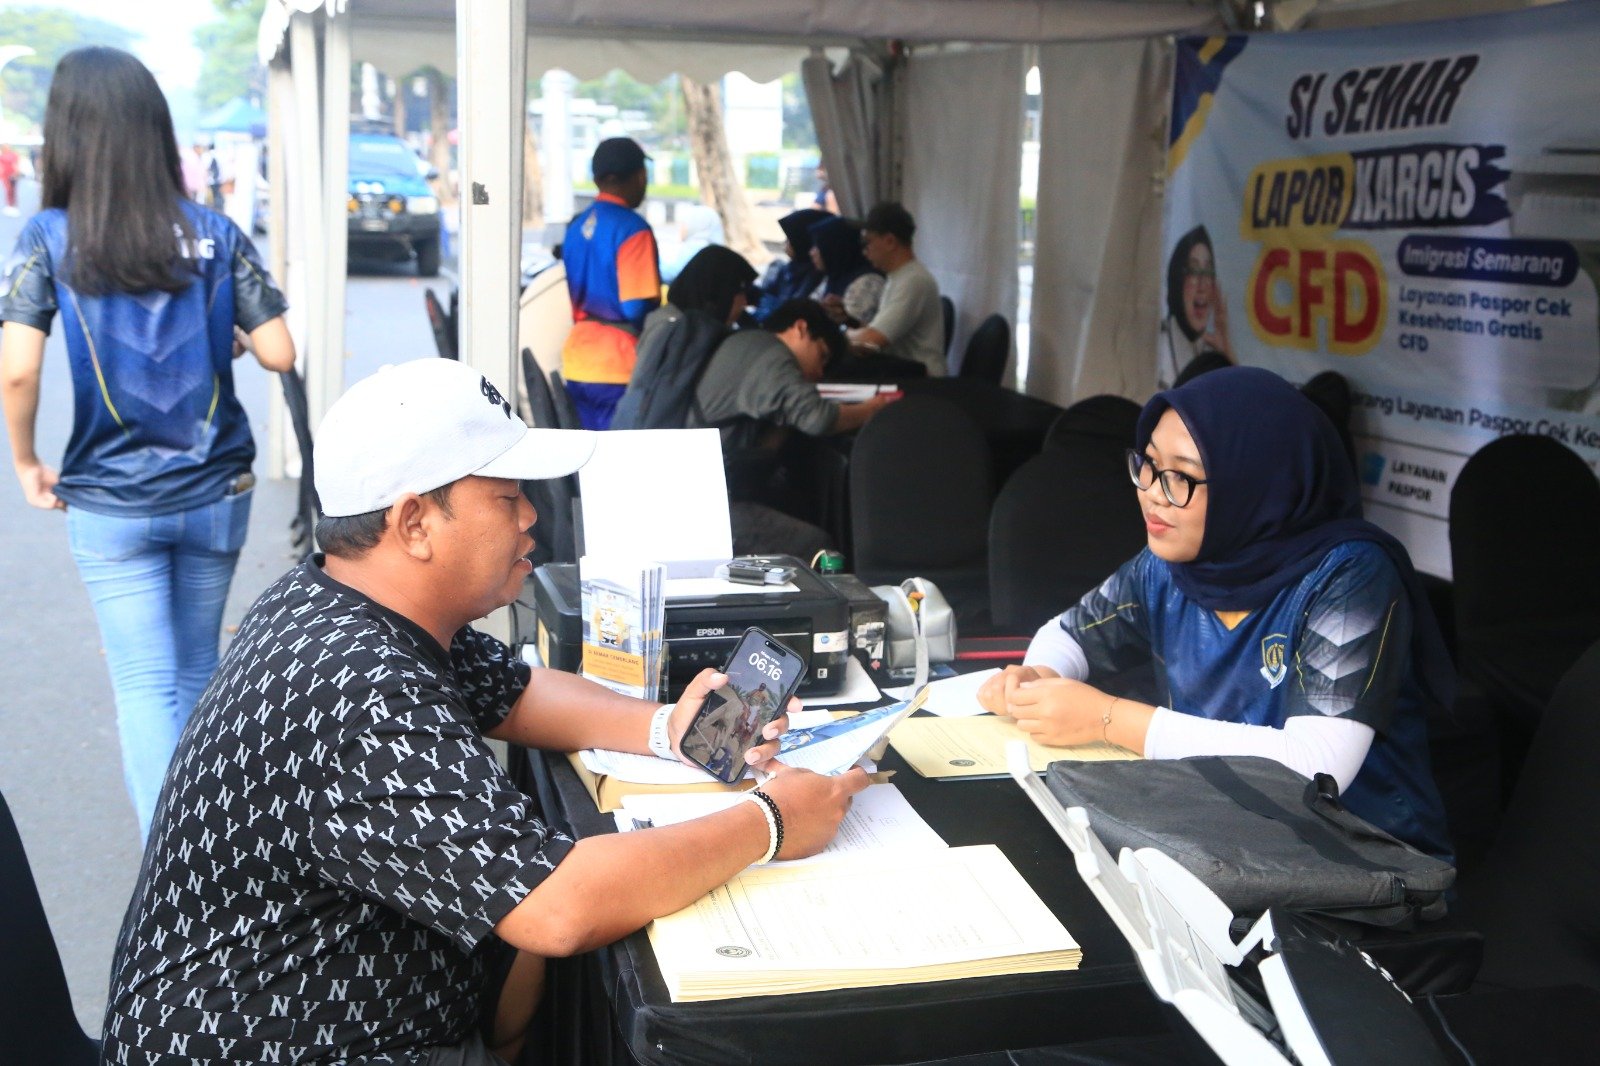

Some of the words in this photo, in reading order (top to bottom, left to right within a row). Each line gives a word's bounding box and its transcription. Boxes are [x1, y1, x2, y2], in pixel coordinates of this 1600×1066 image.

[1286, 73, 1326, 140] SI
[1324, 54, 1479, 136] SEMAR
[1252, 166, 1345, 229] LAPOR
[1350, 147, 1480, 223] KARCIS
[1403, 245, 1470, 272] Imigrasi
[1472, 247, 1563, 280] Semarang
[1252, 248, 1381, 344] CFD
[1400, 285, 1466, 309] Layanan
[1470, 291, 1530, 316] Paspor
[1535, 298, 1572, 317] Cek
[1399, 311, 1485, 335] Kesehatan
[1488, 320, 1543, 341] Gratis
[1399, 333, 1429, 351] CFD
[1397, 397, 1464, 425] Layanan
[696, 628, 725, 637] EPSON
[748, 652, 783, 681] 06.16
